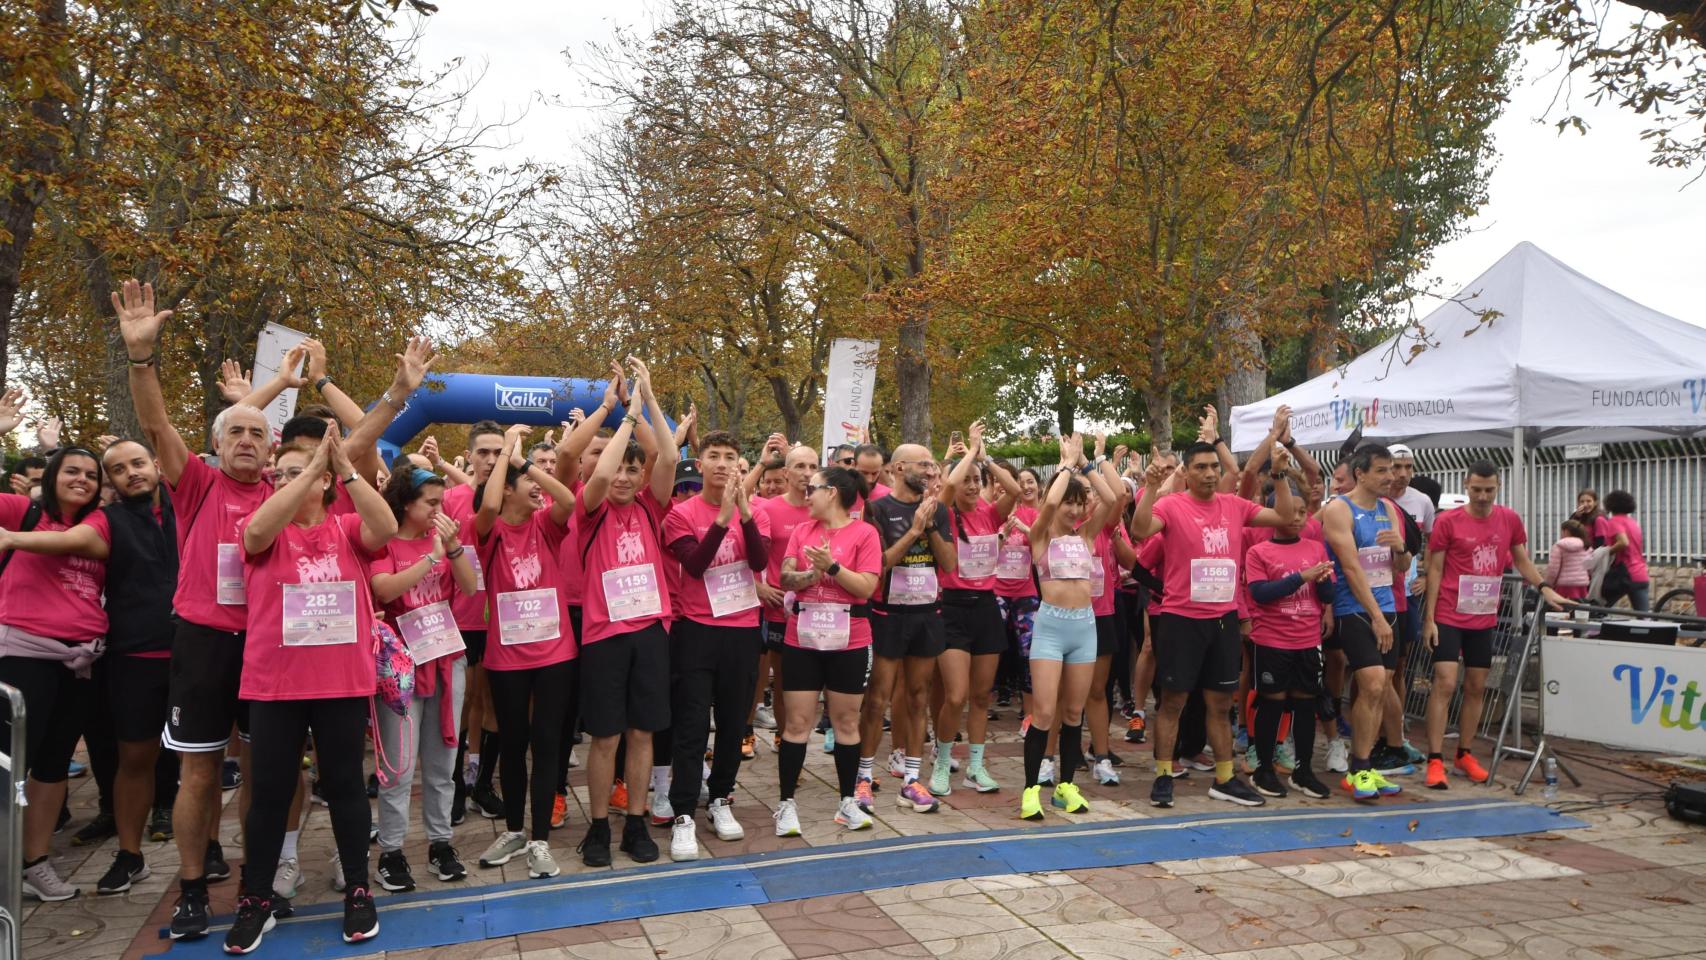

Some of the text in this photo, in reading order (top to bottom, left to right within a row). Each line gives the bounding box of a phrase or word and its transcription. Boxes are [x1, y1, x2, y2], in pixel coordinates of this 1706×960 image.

[850, 351, 865, 419] FUNDAZIOA
[500, 391, 548, 407] Kaiku
[1592, 388, 1681, 407] FUNDACIÓN
[1329, 398, 1379, 431] Vital
[1383, 399, 1454, 419] FUNDAZIOA
[971, 543, 990, 553] 275
[1058, 543, 1085, 553] 1043
[720, 571, 742, 585] 721
[1202, 567, 1229, 577] 1566
[616, 574, 648, 589] 1159
[906, 575, 926, 585] 399
[1473, 582, 1492, 592] 537
[305, 593, 338, 608] 282
[515, 599, 542, 612] 702
[413, 612, 446, 630] 1603
[812, 611, 835, 622] 943
[1613, 664, 1706, 731] Vit
